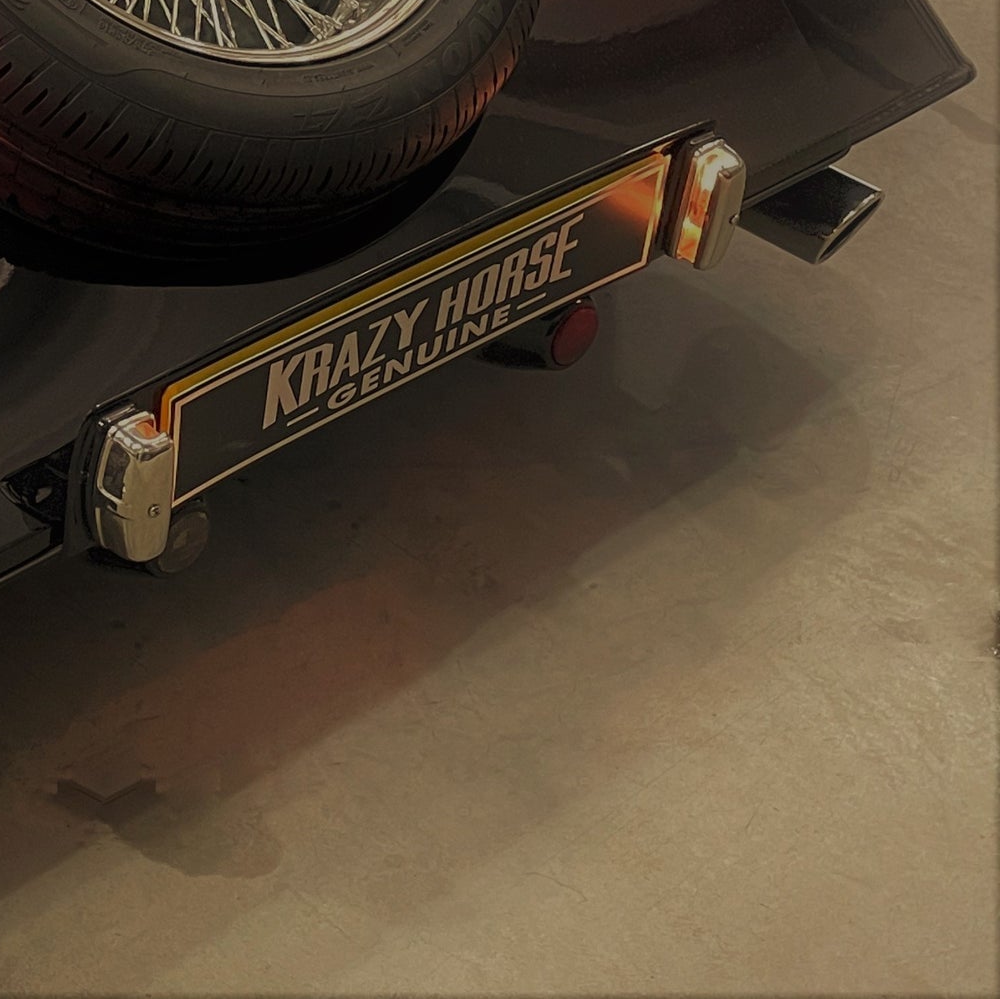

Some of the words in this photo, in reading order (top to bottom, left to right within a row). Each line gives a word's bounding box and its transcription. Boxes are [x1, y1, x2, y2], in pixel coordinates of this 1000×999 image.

[261, 297, 430, 430] KRAZY
[434, 212, 585, 333] HORSE
[326, 303, 511, 410] GENUINE
